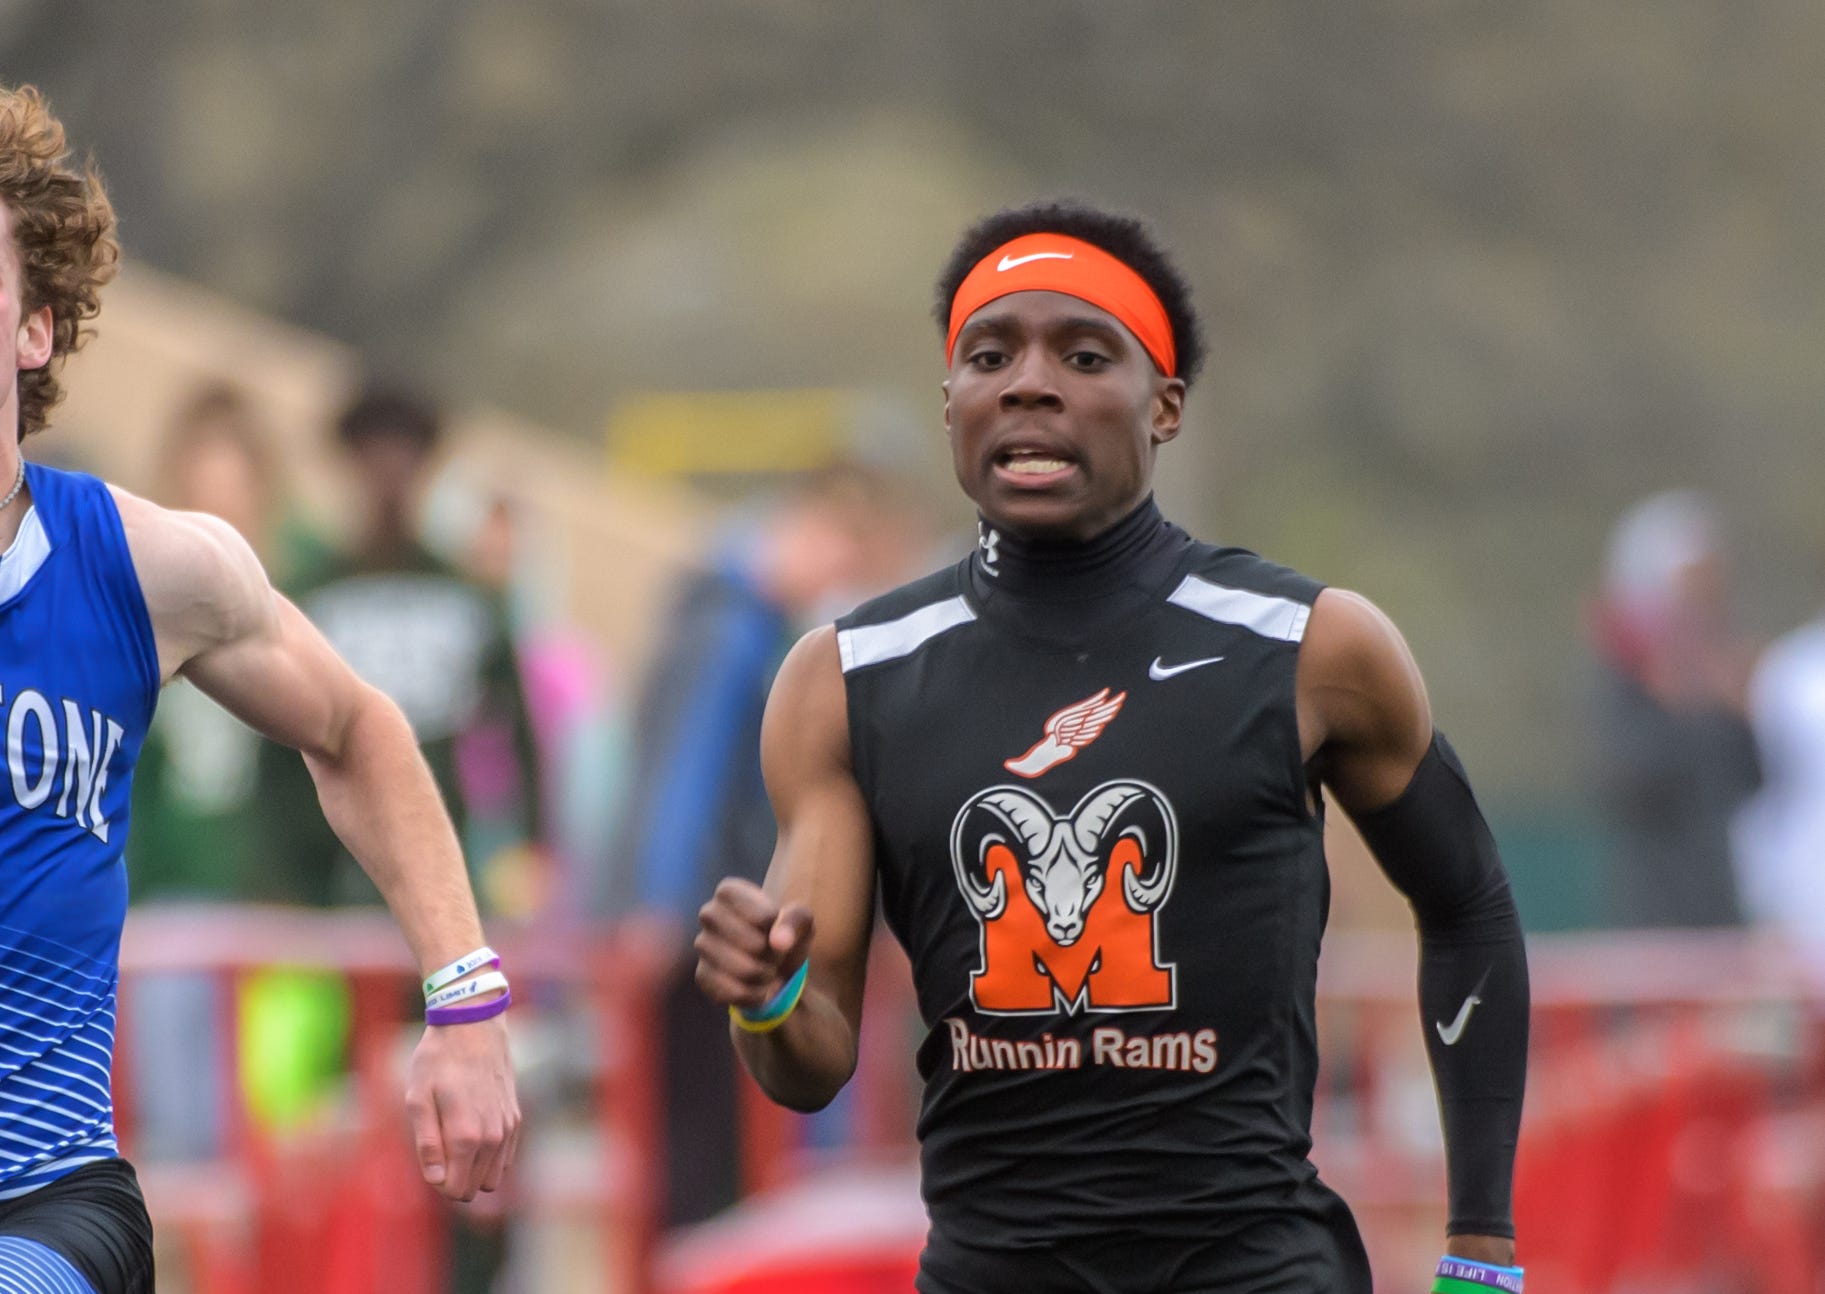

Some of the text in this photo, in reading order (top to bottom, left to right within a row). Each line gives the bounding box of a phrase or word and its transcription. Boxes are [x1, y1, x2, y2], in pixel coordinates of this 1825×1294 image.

[970, 836, 1177, 1016] M
[948, 1018, 1219, 1073] Runnin Rams
[1456, 1264, 1486, 1281] LIFE
